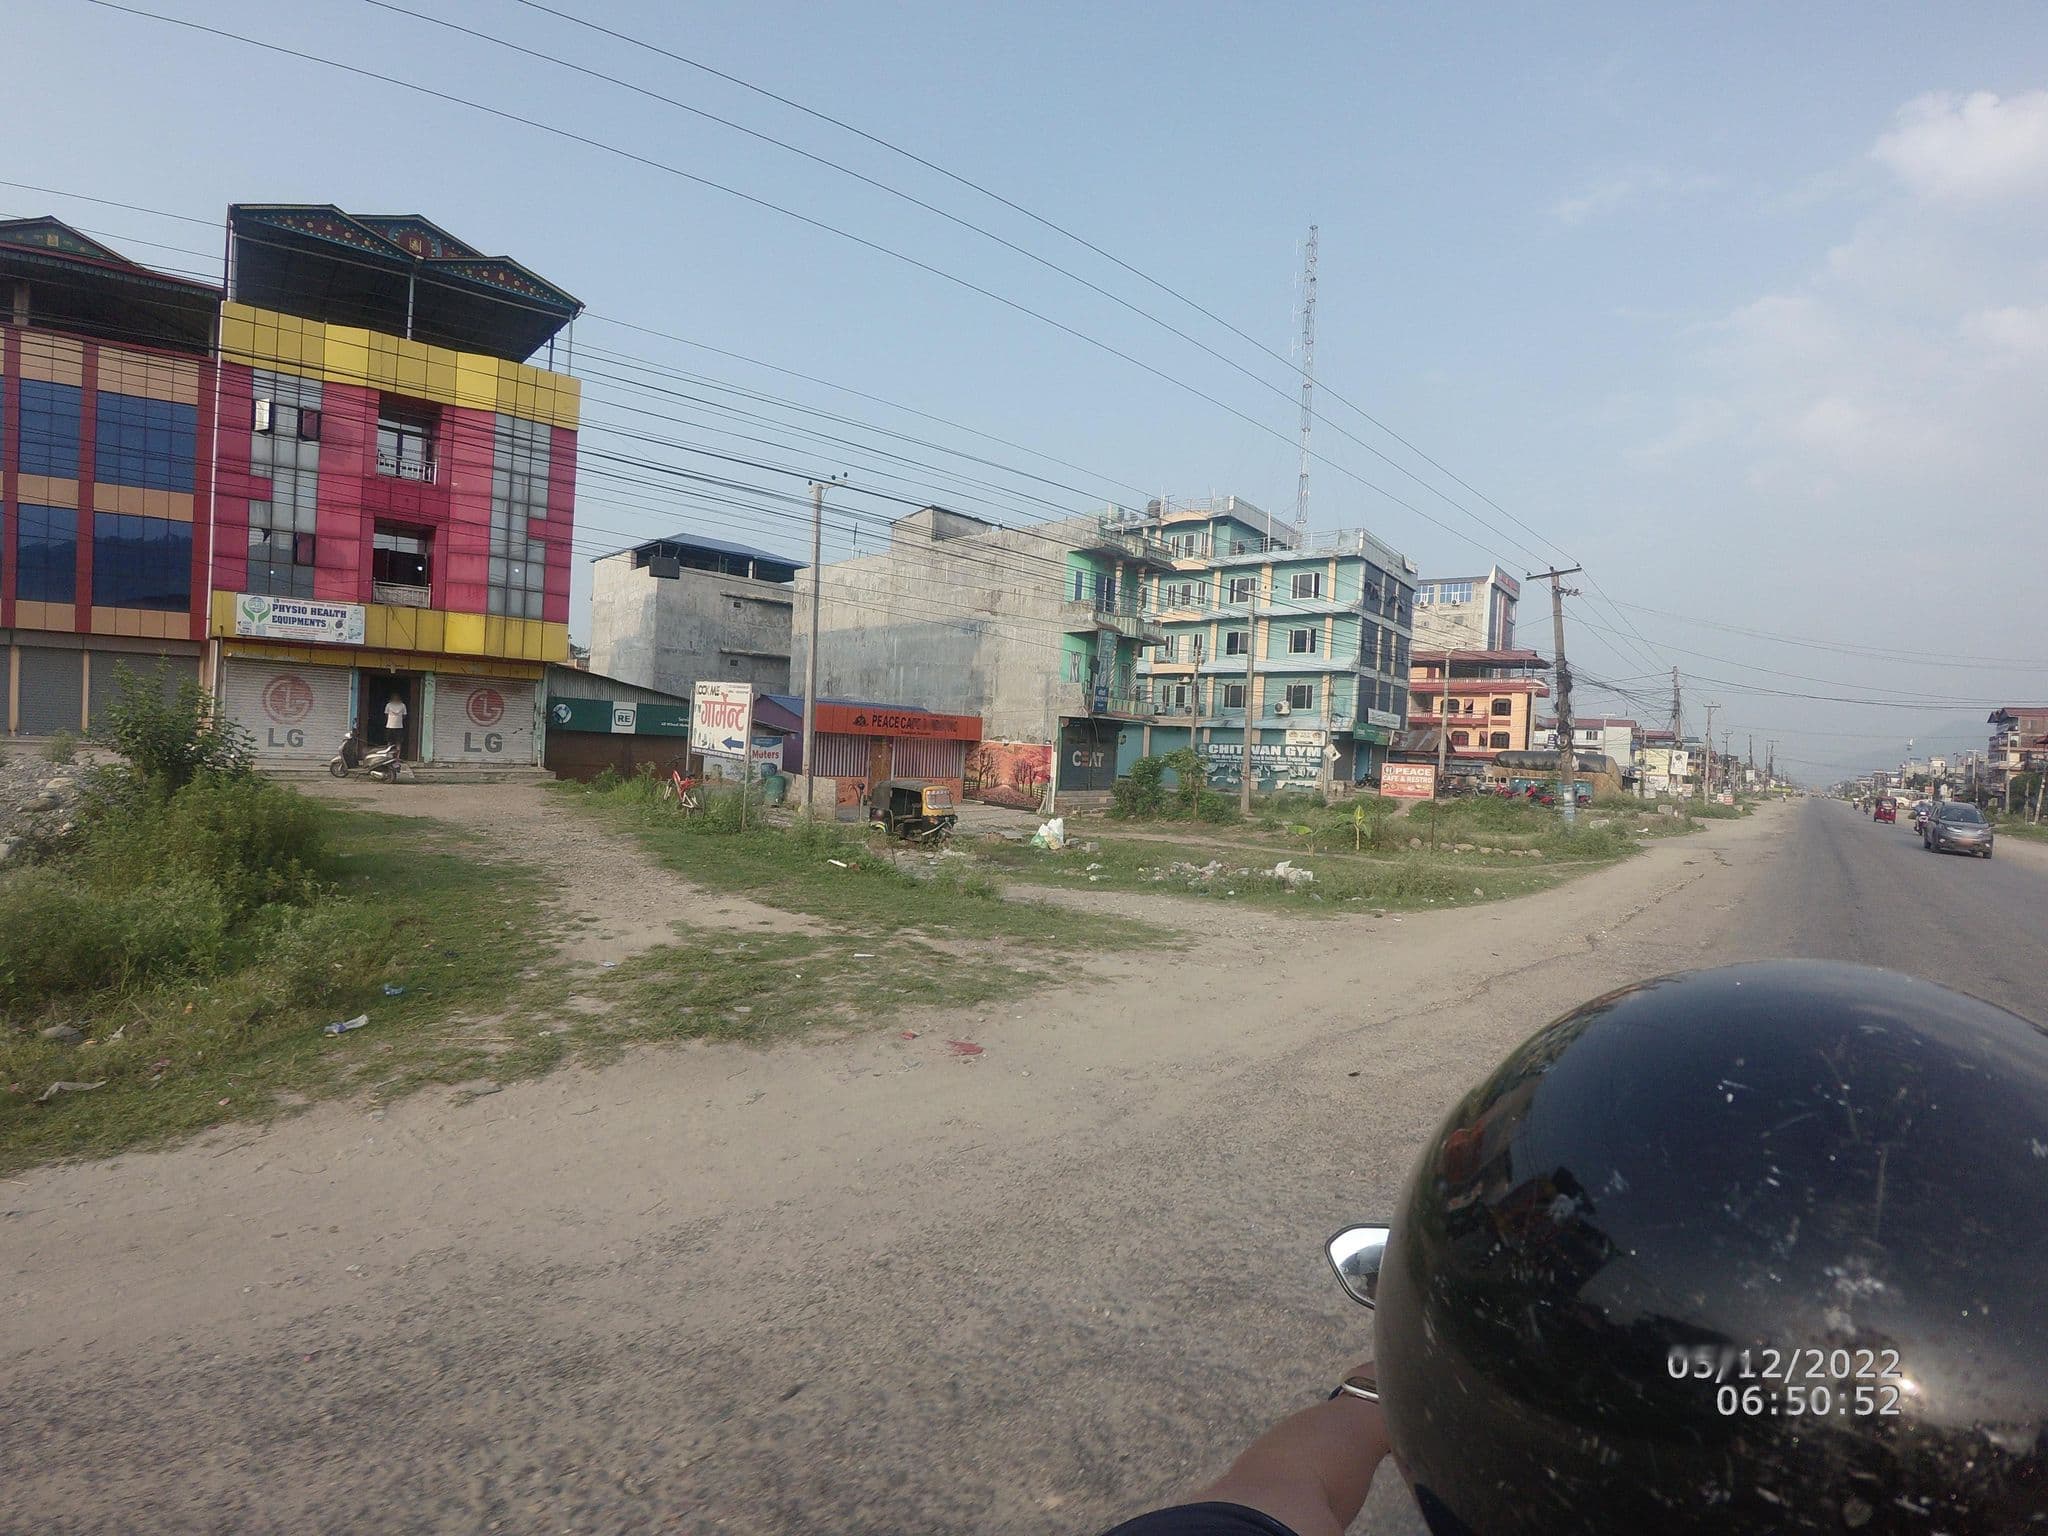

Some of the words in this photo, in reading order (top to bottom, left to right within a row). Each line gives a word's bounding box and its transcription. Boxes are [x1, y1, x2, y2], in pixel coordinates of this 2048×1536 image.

[272, 603, 307, 615] PHYSIO
[310, 607, 347, 619] HEALTH
[272, 615, 327, 628] EQUIPMENTS
[617, 714, 631, 723] RE
[871, 714, 900, 728] PEACE
[268, 727, 304, 748] LG
[464, 732, 503, 753] LG
[1284, 745, 1322, 757] GYM
[1072, 750, 1104, 767] CEAT
[1395, 767, 1433, 777] PEACE
